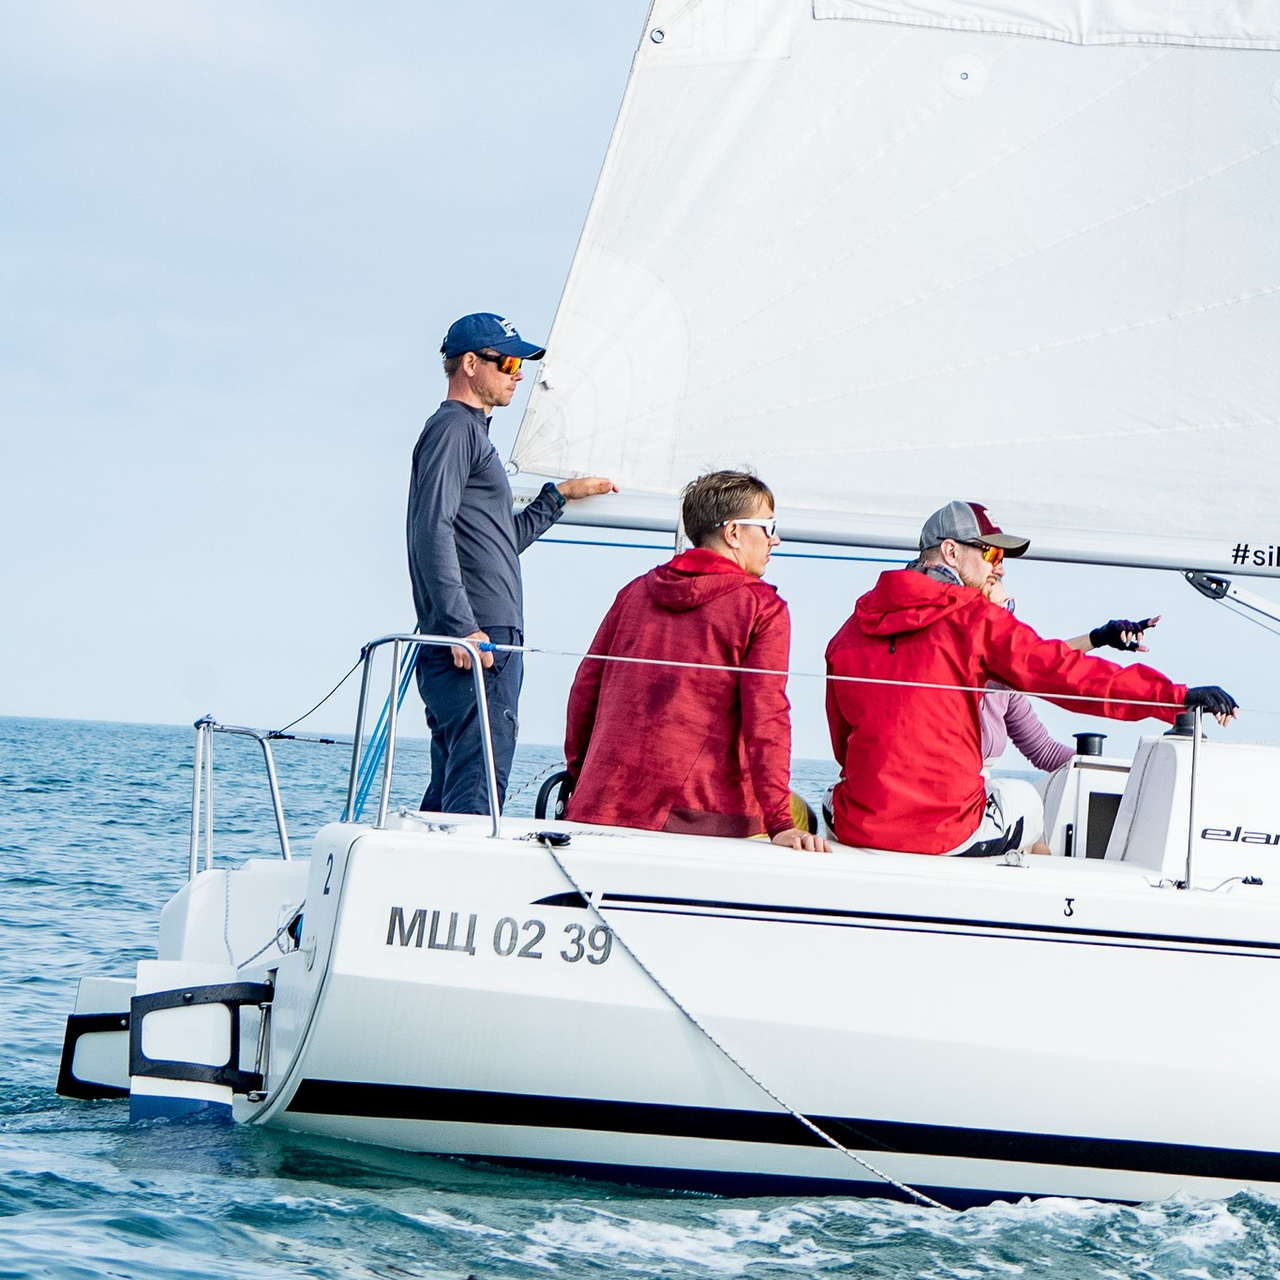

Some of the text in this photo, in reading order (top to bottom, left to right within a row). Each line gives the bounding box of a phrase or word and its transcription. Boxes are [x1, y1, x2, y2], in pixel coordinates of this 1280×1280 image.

[323, 853, 334, 895] 2
[386, 907, 613, 965] МЩ 02 39
